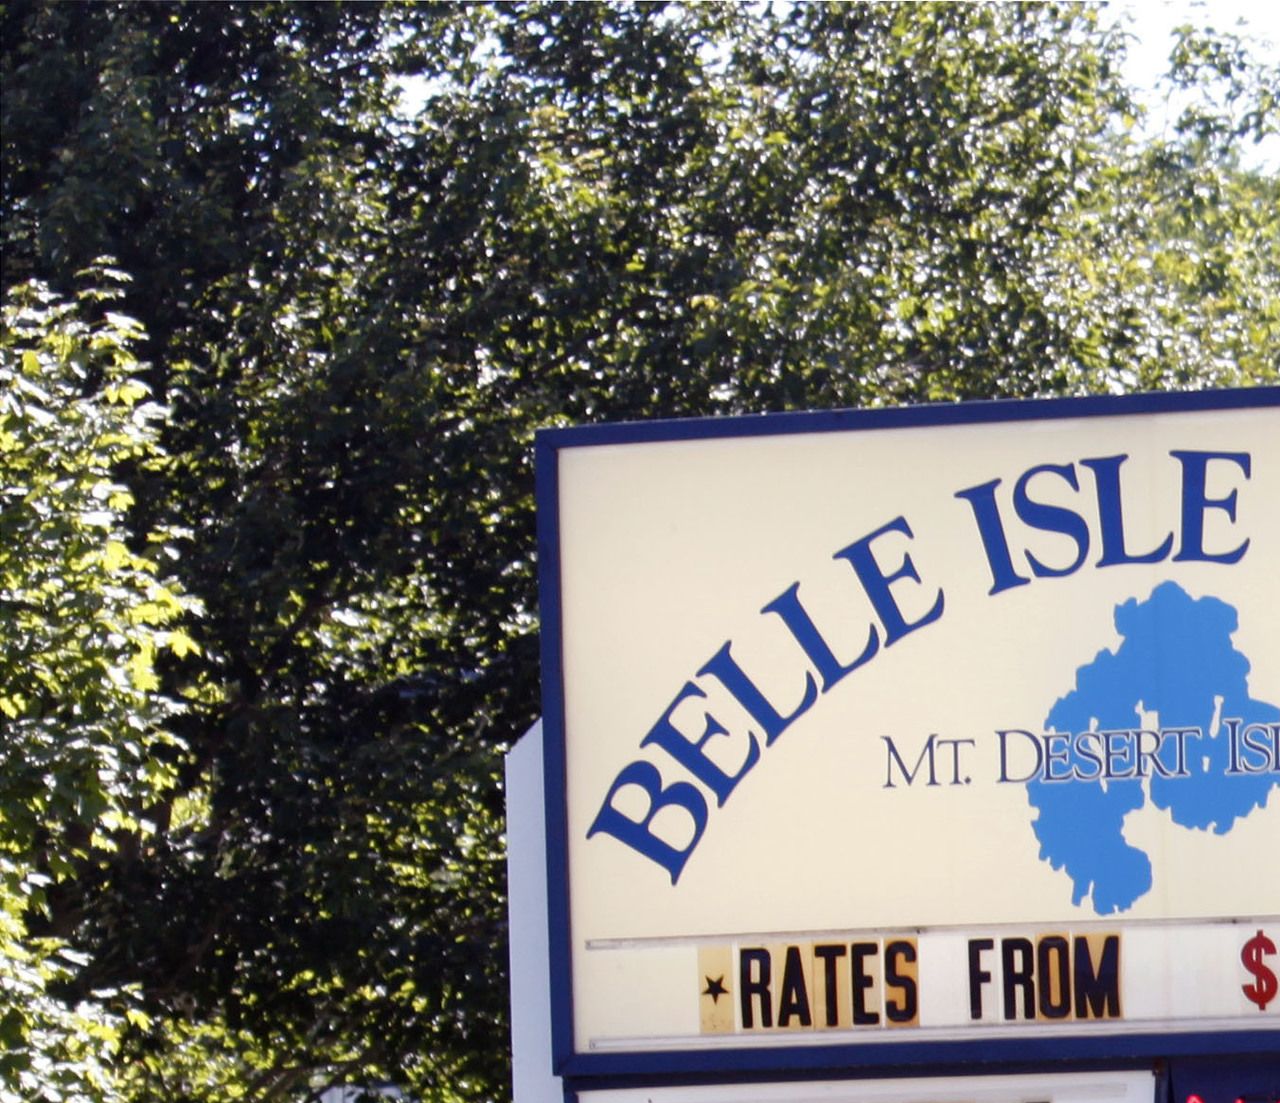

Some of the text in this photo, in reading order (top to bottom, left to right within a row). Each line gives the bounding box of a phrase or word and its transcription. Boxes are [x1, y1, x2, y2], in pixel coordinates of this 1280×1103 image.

[586, 515, 945, 886] BELLE
[955, 449, 1252, 595] ISLE
[880, 732, 976, 788] MT.
[995, 727, 1202, 784] DESERT
[739, 940, 918, 1030] RATES
[967, 935, 1122, 1022] FROM
